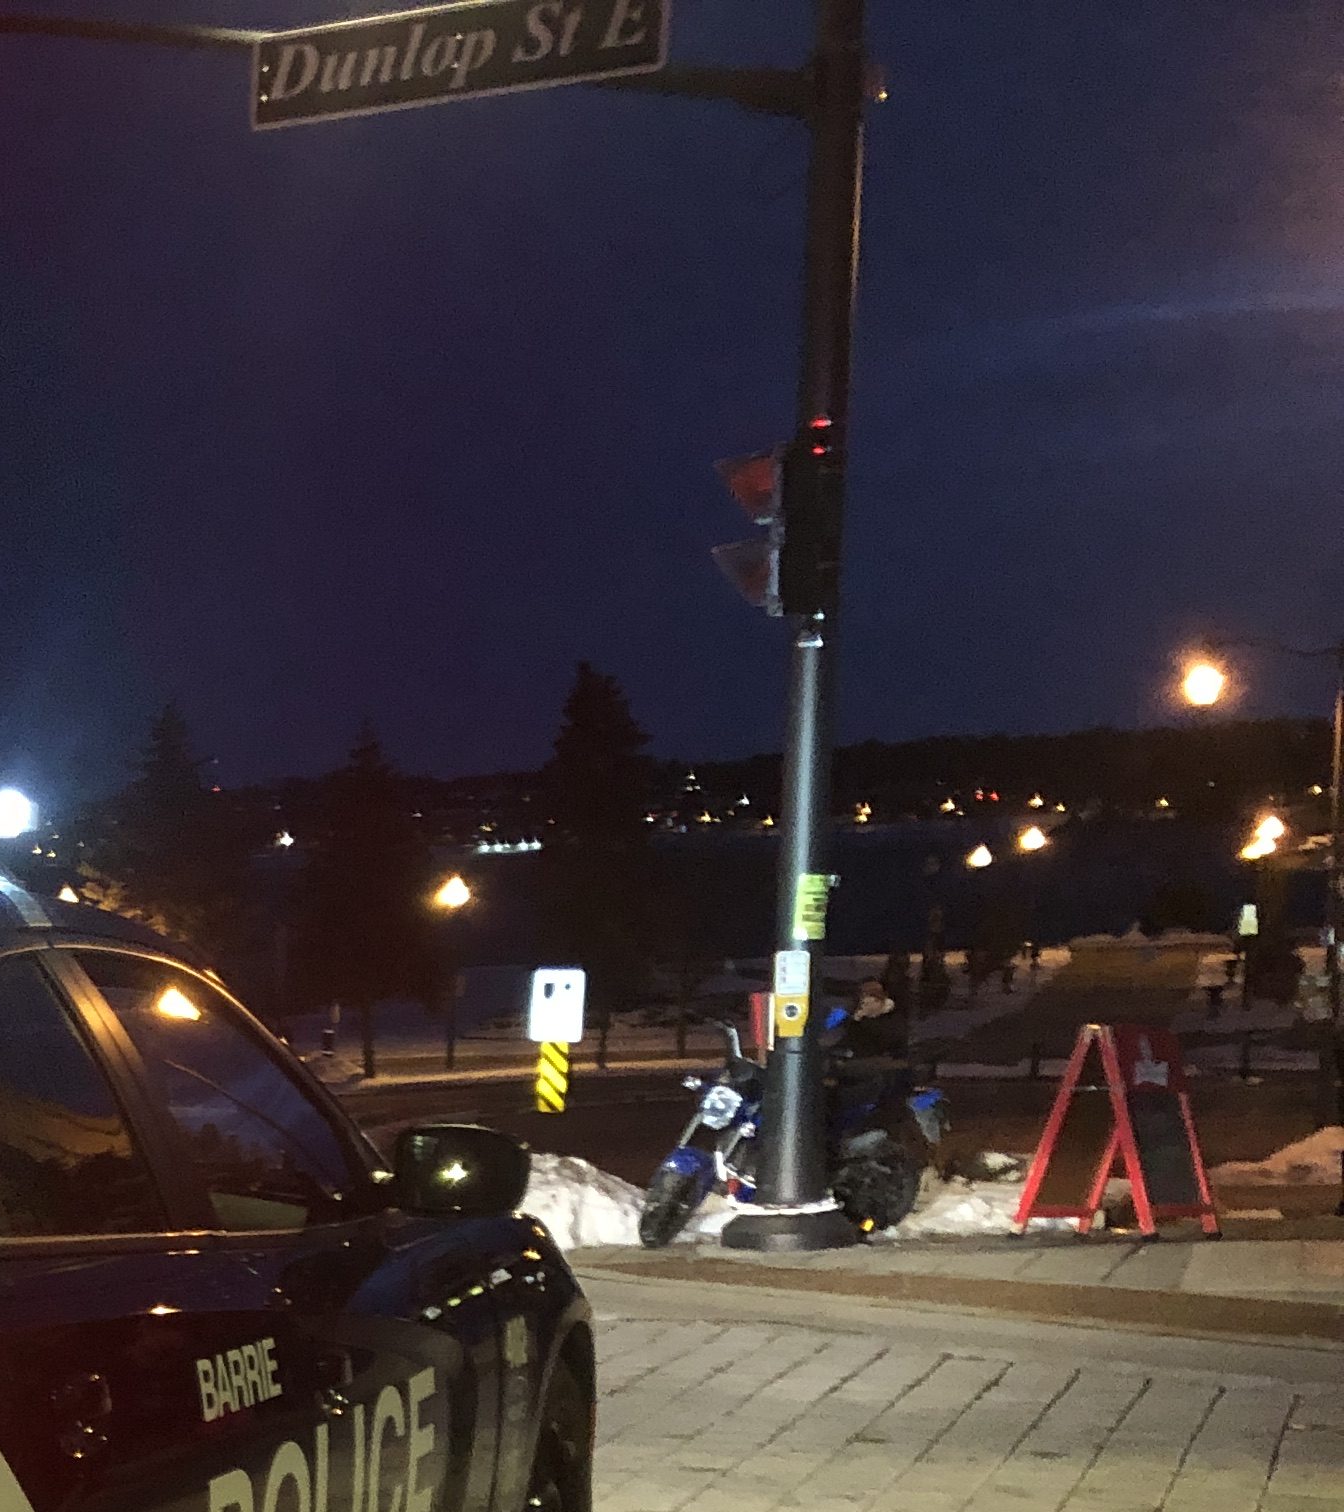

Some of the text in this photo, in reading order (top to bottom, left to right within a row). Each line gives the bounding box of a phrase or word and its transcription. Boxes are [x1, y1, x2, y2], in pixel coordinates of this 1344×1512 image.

[270, 0, 648, 101] Dunlop St E
[196, 1337, 283, 1422] BARRIE
